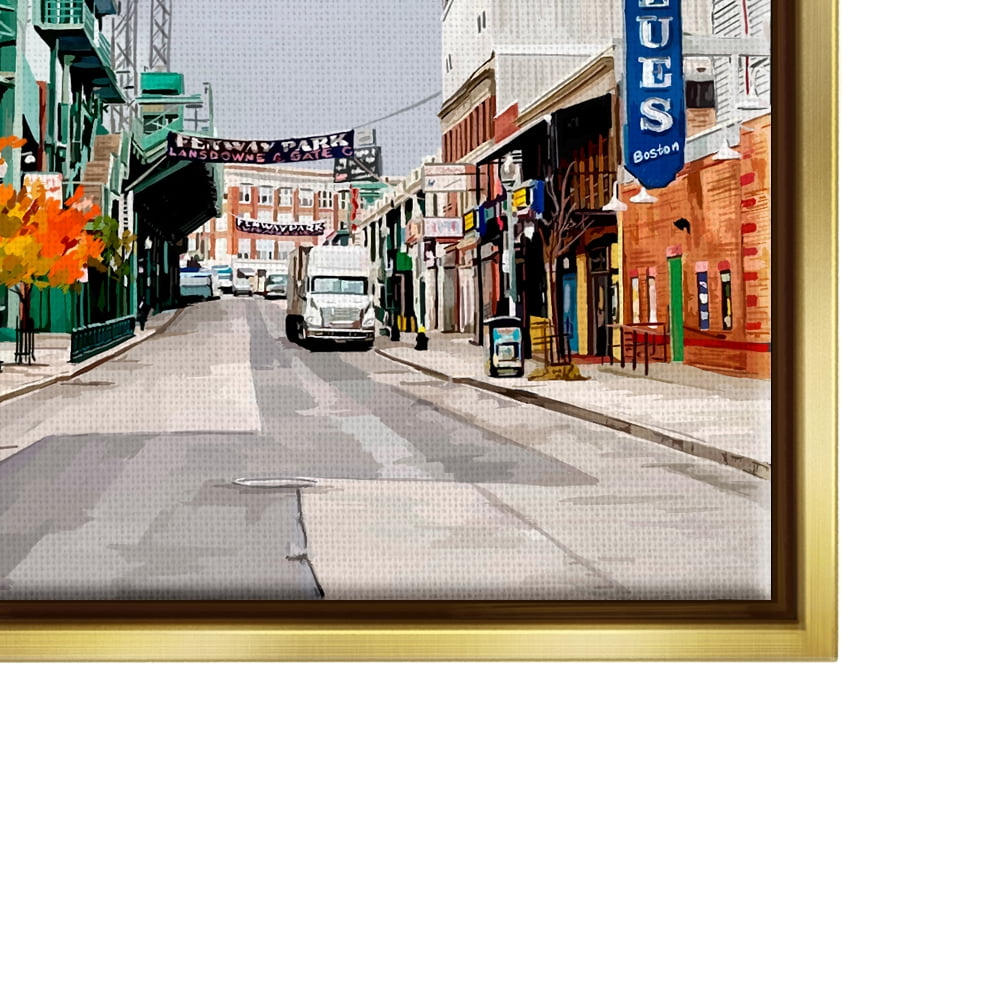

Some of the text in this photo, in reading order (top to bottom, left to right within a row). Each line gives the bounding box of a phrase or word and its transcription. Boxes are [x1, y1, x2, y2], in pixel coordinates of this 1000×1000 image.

[281, 133, 349, 152] PARK
[168, 147, 266, 163] LANSDOWNE
[290, 148, 333, 161] GATE
[632, 141, 680, 164] Boston
